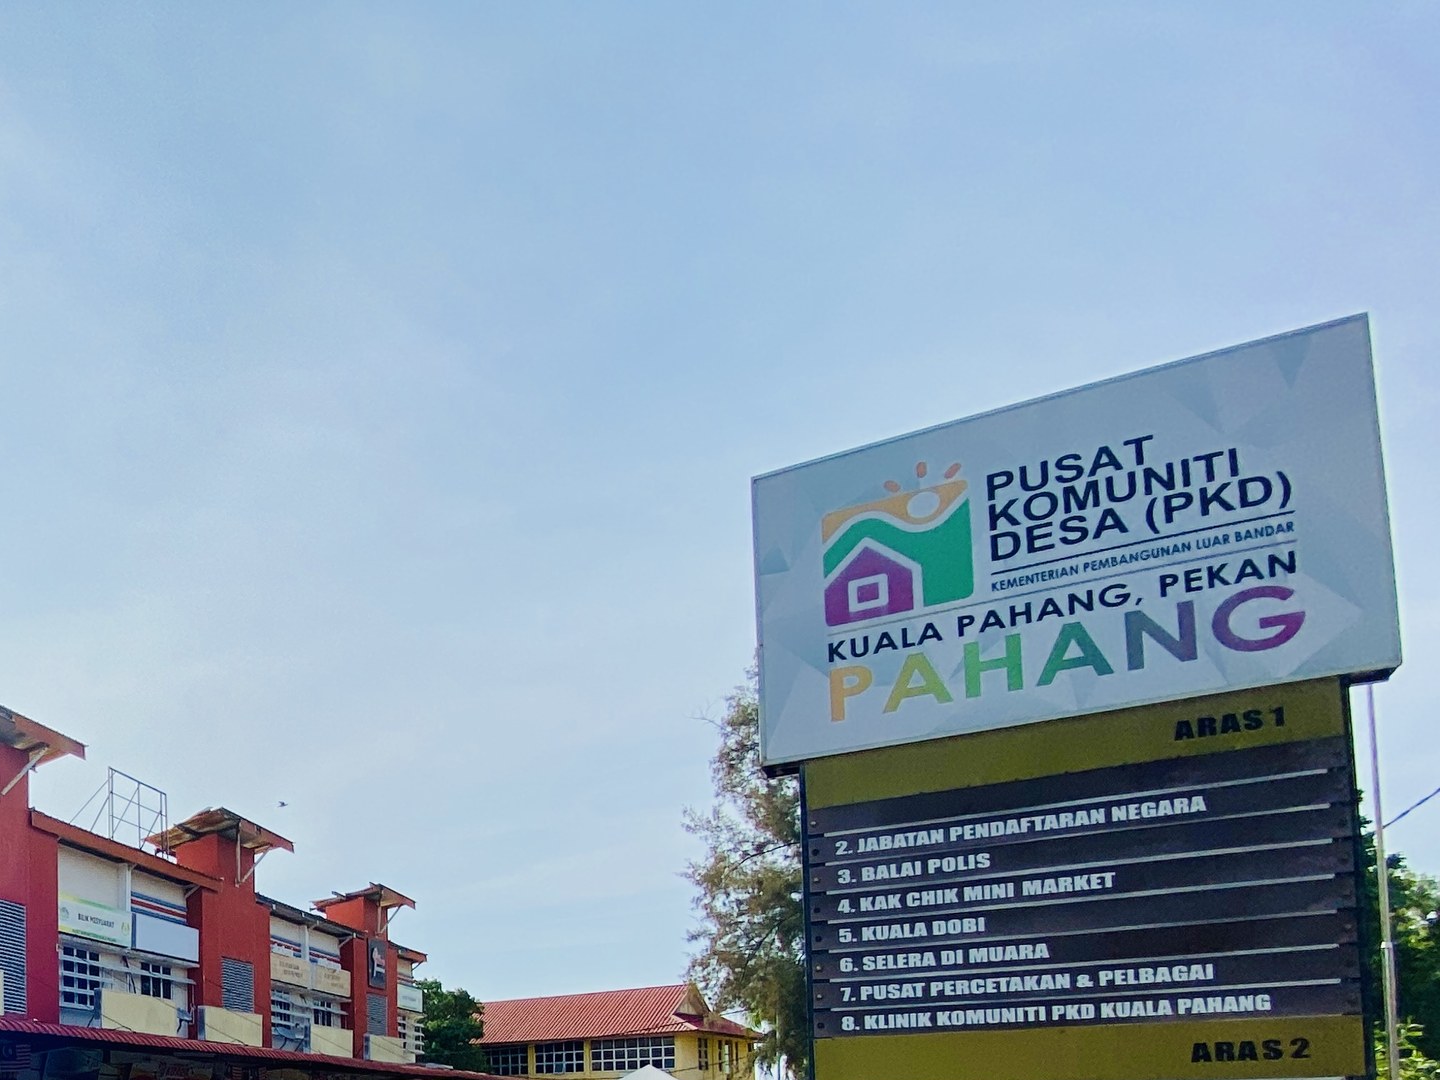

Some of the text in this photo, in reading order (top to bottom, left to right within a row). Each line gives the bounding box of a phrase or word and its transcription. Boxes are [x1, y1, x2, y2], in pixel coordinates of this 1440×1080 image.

[987, 435, 1153, 501] PUSAT
[989, 448, 1239, 531] KOMUNITI
[990, 473, 1291, 561] DESA (PKD)
[992, 522, 1294, 591] KEMENTERIAN PEMBANGUNAN LUAR BANDAR
[828, 551, 1296, 662] KUALA PAHANG, PEKAN
[828, 585, 1306, 722] PAHANG
[1175, 707, 1285, 741] ARAS 1
[836, 796, 1206, 855] 2. JABATAN PENDAFTARAN NEGARA
[838, 853, 990, 883] 3. BALAI POLIS
[838, 872, 1115, 913] 4. KAK CHIK MINI MARKET
[839, 917, 985, 942] 5. KUALA DOBI
[840, 944, 1049, 972] 6. SELERA DI MUARA
[841, 964, 1213, 1001] 7. PUSAT PERCETAKAN & PELBAGAI
[842, 995, 1271, 1030] 8. KLINIK KOMUNITI PKD KUALA PAHANG
[1191, 1038, 1310, 1062] ARAS 2
